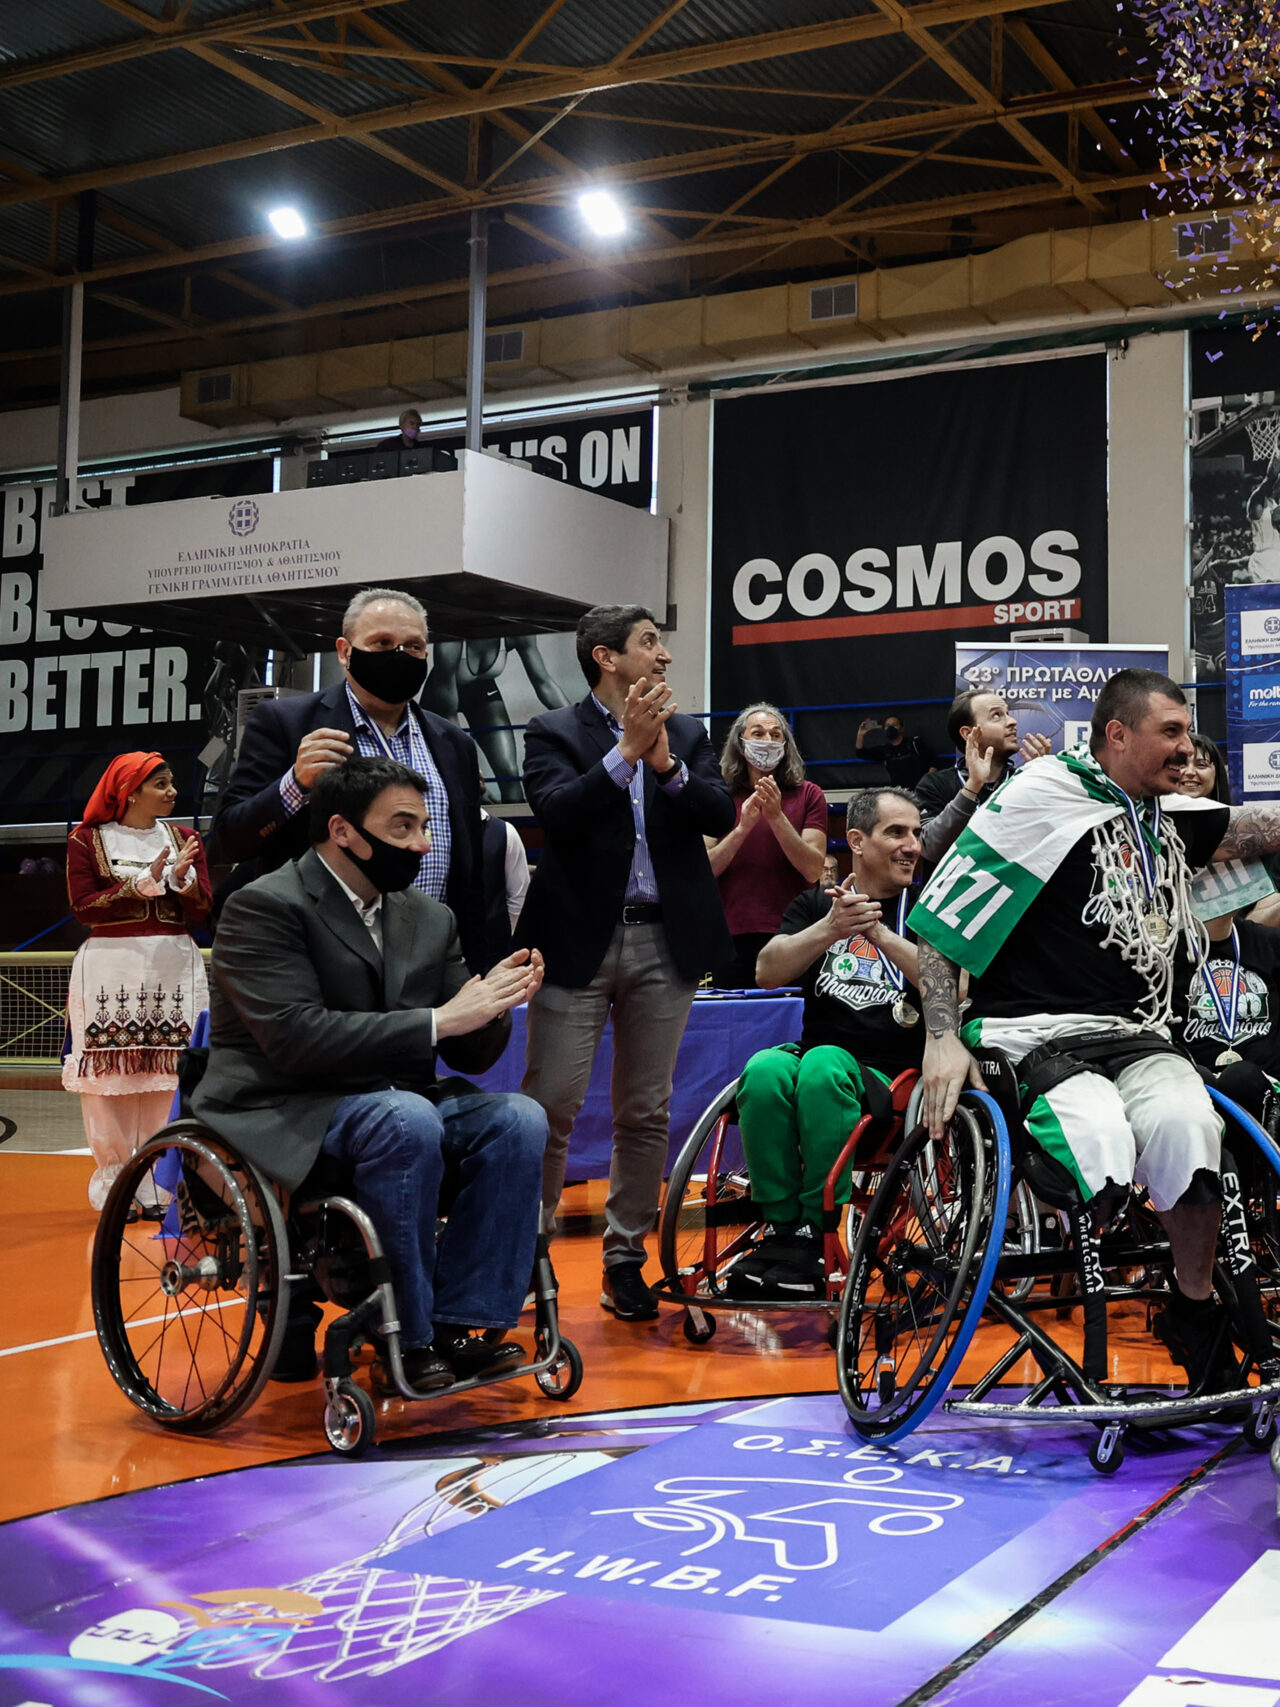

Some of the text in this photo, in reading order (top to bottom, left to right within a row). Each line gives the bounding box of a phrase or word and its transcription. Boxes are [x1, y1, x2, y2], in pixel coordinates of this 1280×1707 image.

[579, 425, 641, 488] ON
[267, 558, 274, 566] &
[732, 530, 1081, 621] COSMOS
[993, 599, 1076, 625] SPORT
[0, 646, 201, 733] BETTER.
[1052, 688, 1072, 702] με
[1078, 1215, 1094, 1293] WHEELCHAIR
[1223, 1172, 1252, 1273] EXTRA
[497, 1547, 797, 1602] H.W.B.F.
